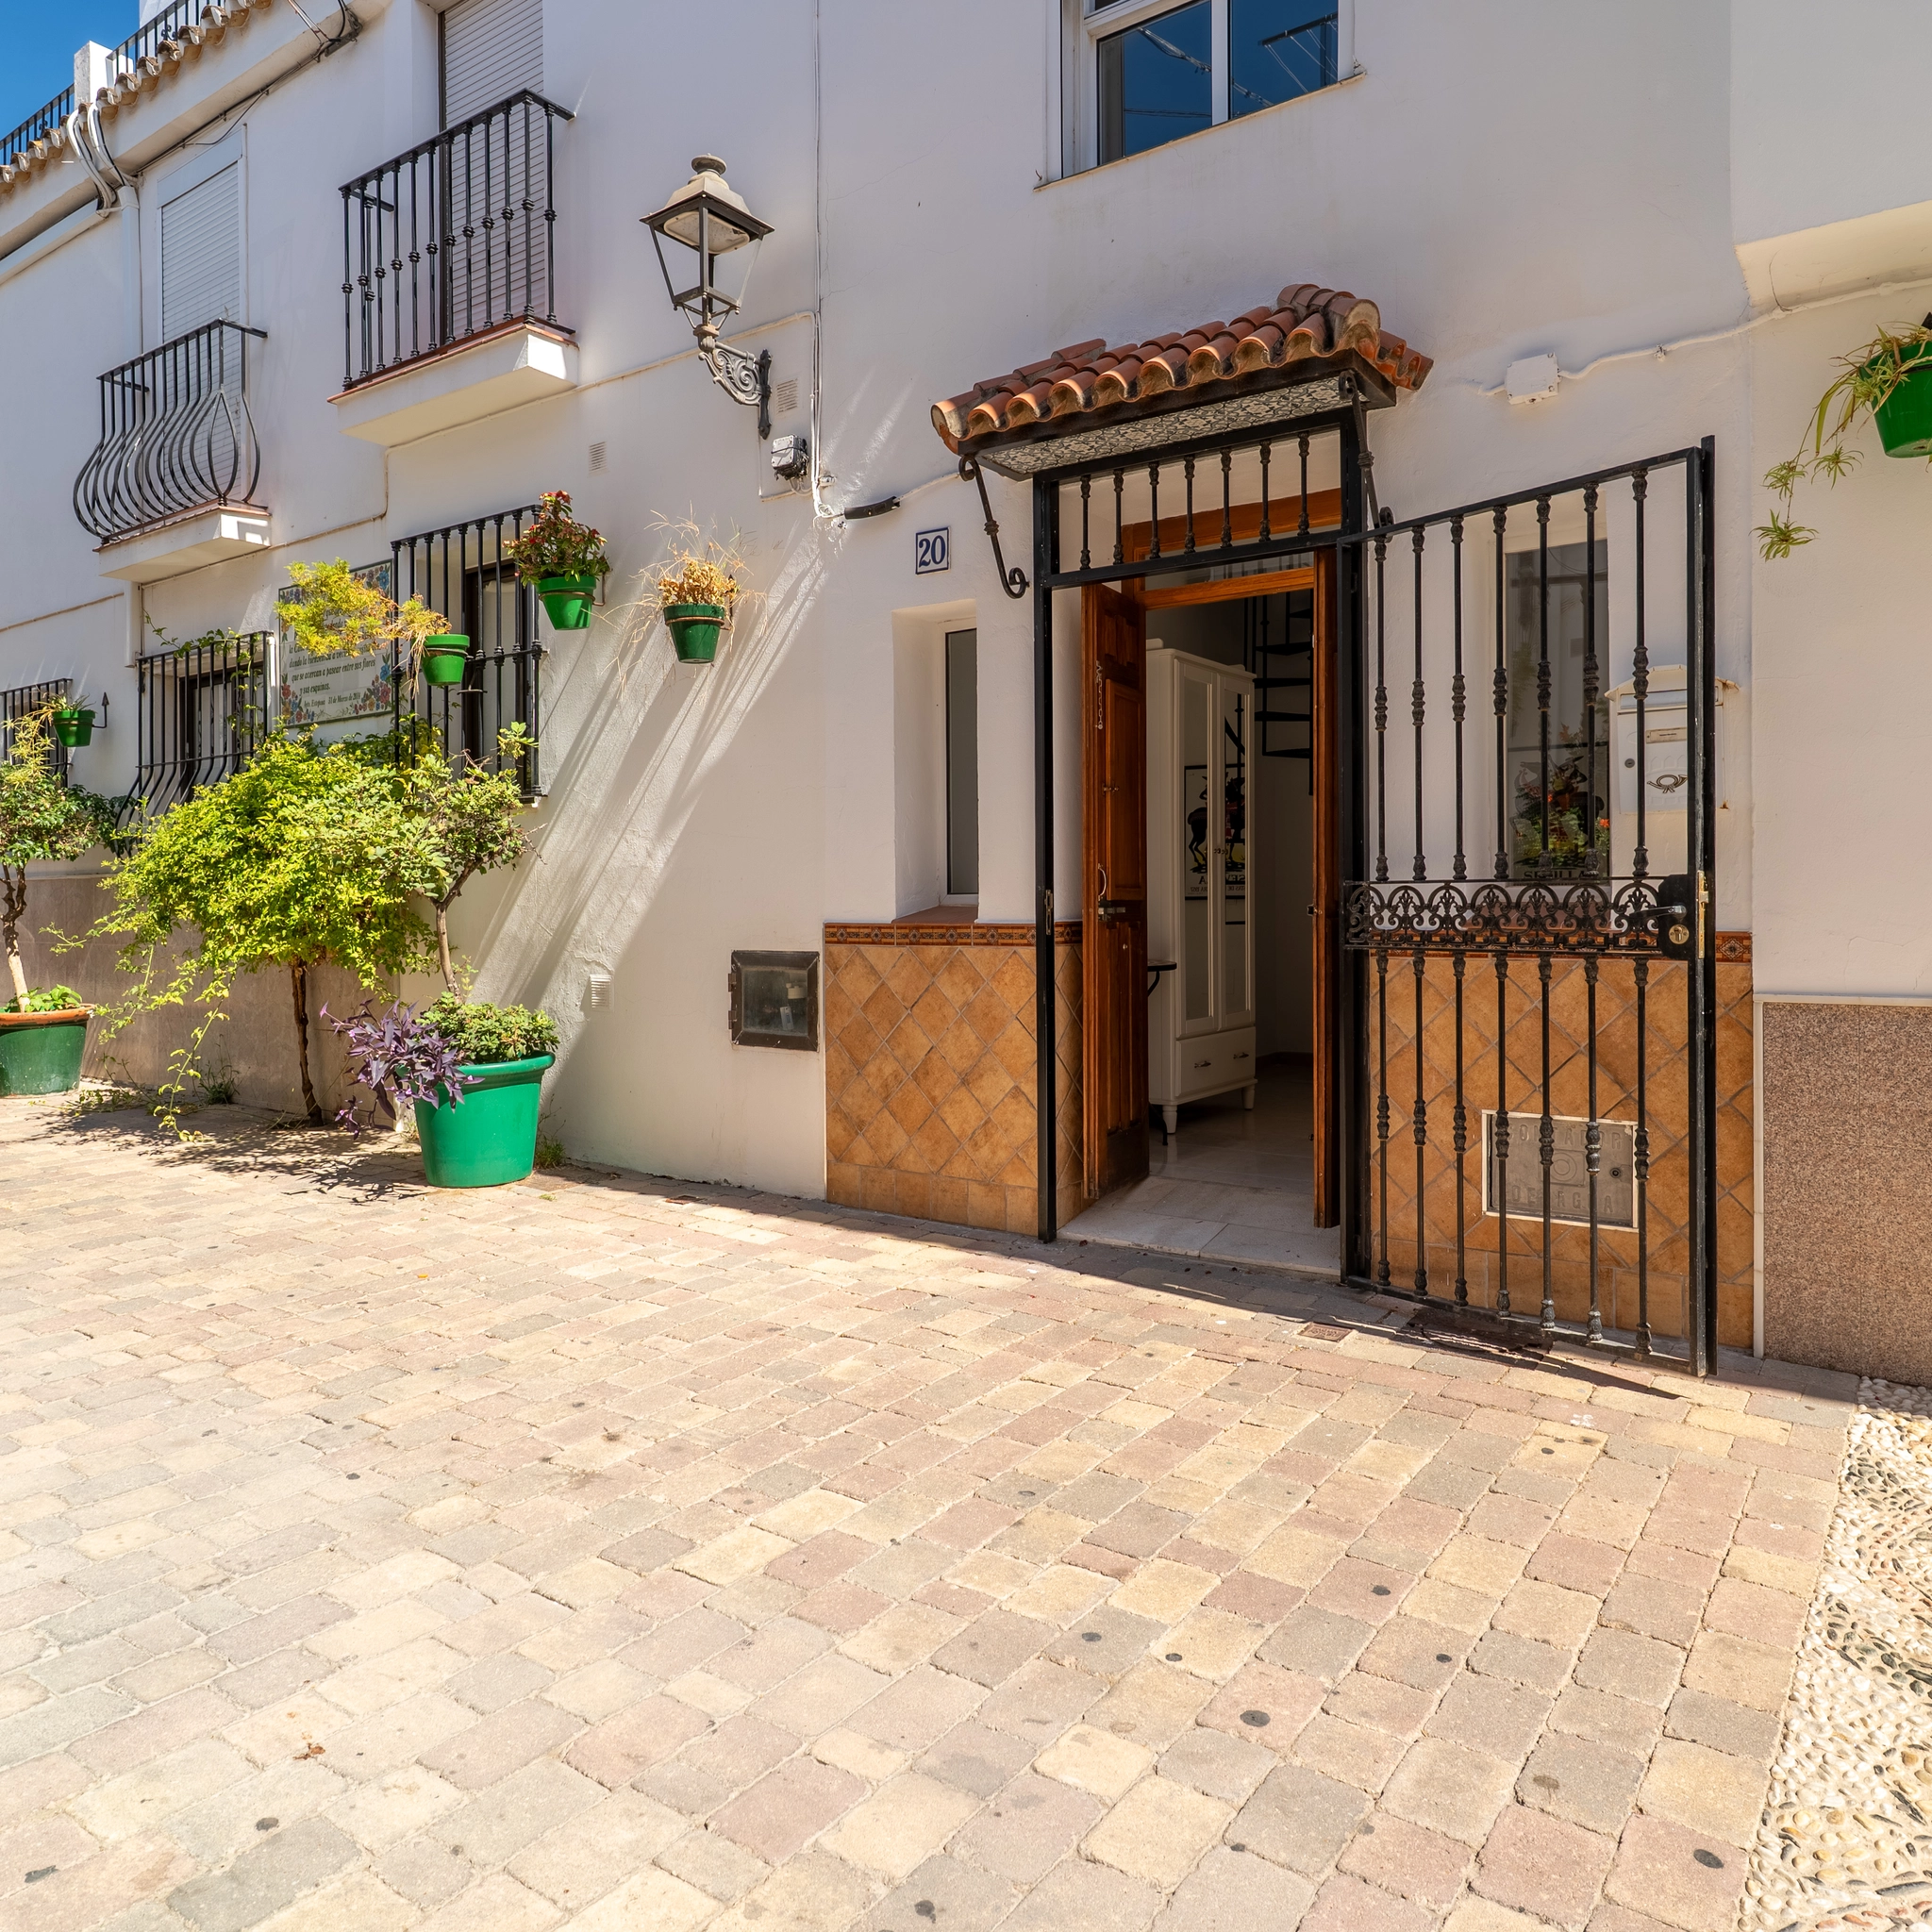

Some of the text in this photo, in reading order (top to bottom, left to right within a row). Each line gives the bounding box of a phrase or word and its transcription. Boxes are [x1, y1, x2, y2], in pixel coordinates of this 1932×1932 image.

[918, 535, 946, 568] 20
[289, 657, 303, 668] dando
[302, 656, 308, 665] la
[291, 674, 300, 684] que
[304, 669, 322, 679] acercan
[325, 666, 341, 677] pasear
[341, 663, 354, 673] entre
[354, 661, 362, 671] sus
[361, 658, 375, 672] flores
[302, 686, 310, 694] sus
[1557, 1190, 1614, 1214] AGA
